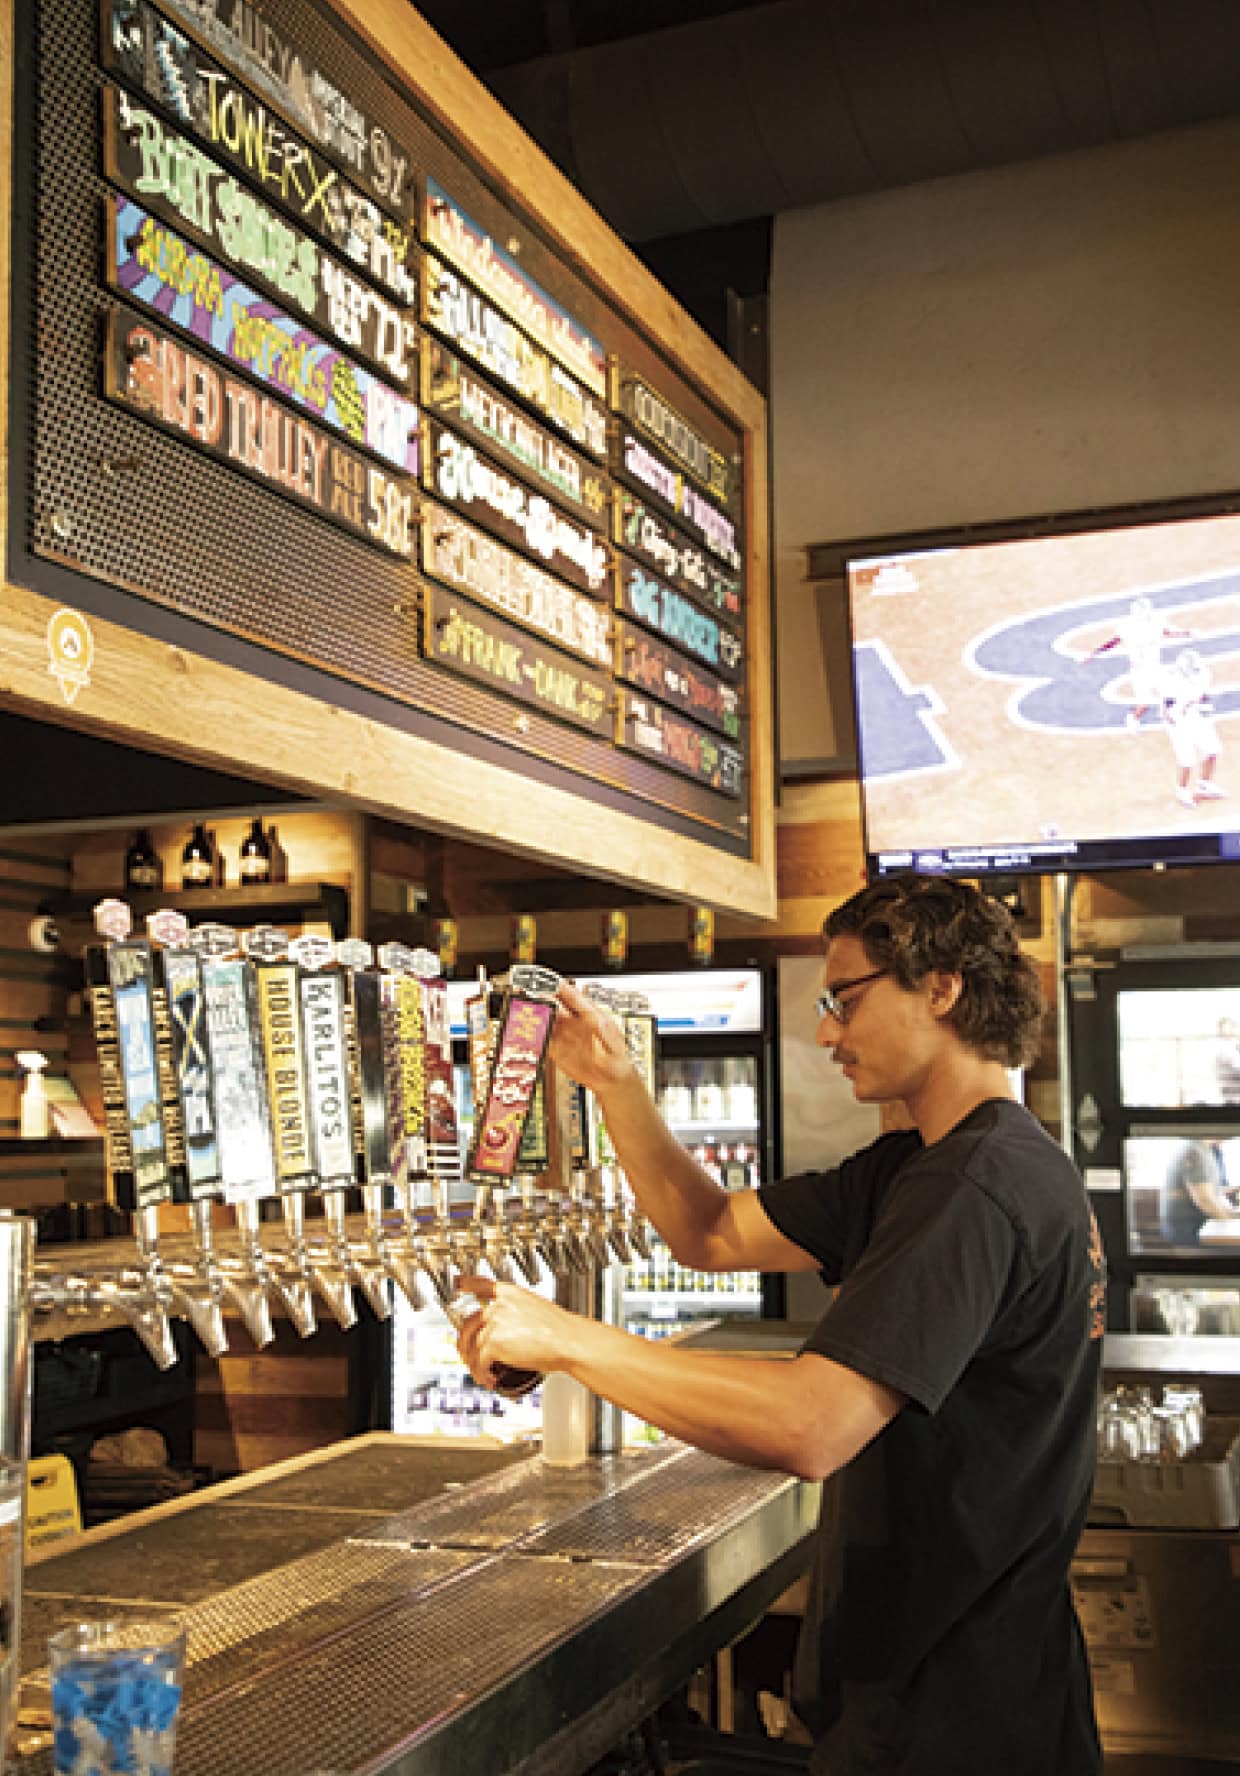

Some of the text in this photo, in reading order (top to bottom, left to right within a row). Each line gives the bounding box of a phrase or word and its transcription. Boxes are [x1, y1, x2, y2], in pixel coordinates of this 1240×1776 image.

[198, 70, 306, 198] TOWER
[267, 978, 305, 1161] HOUSE BLONDE
[307, 983, 343, 1138] KARLITO'S
